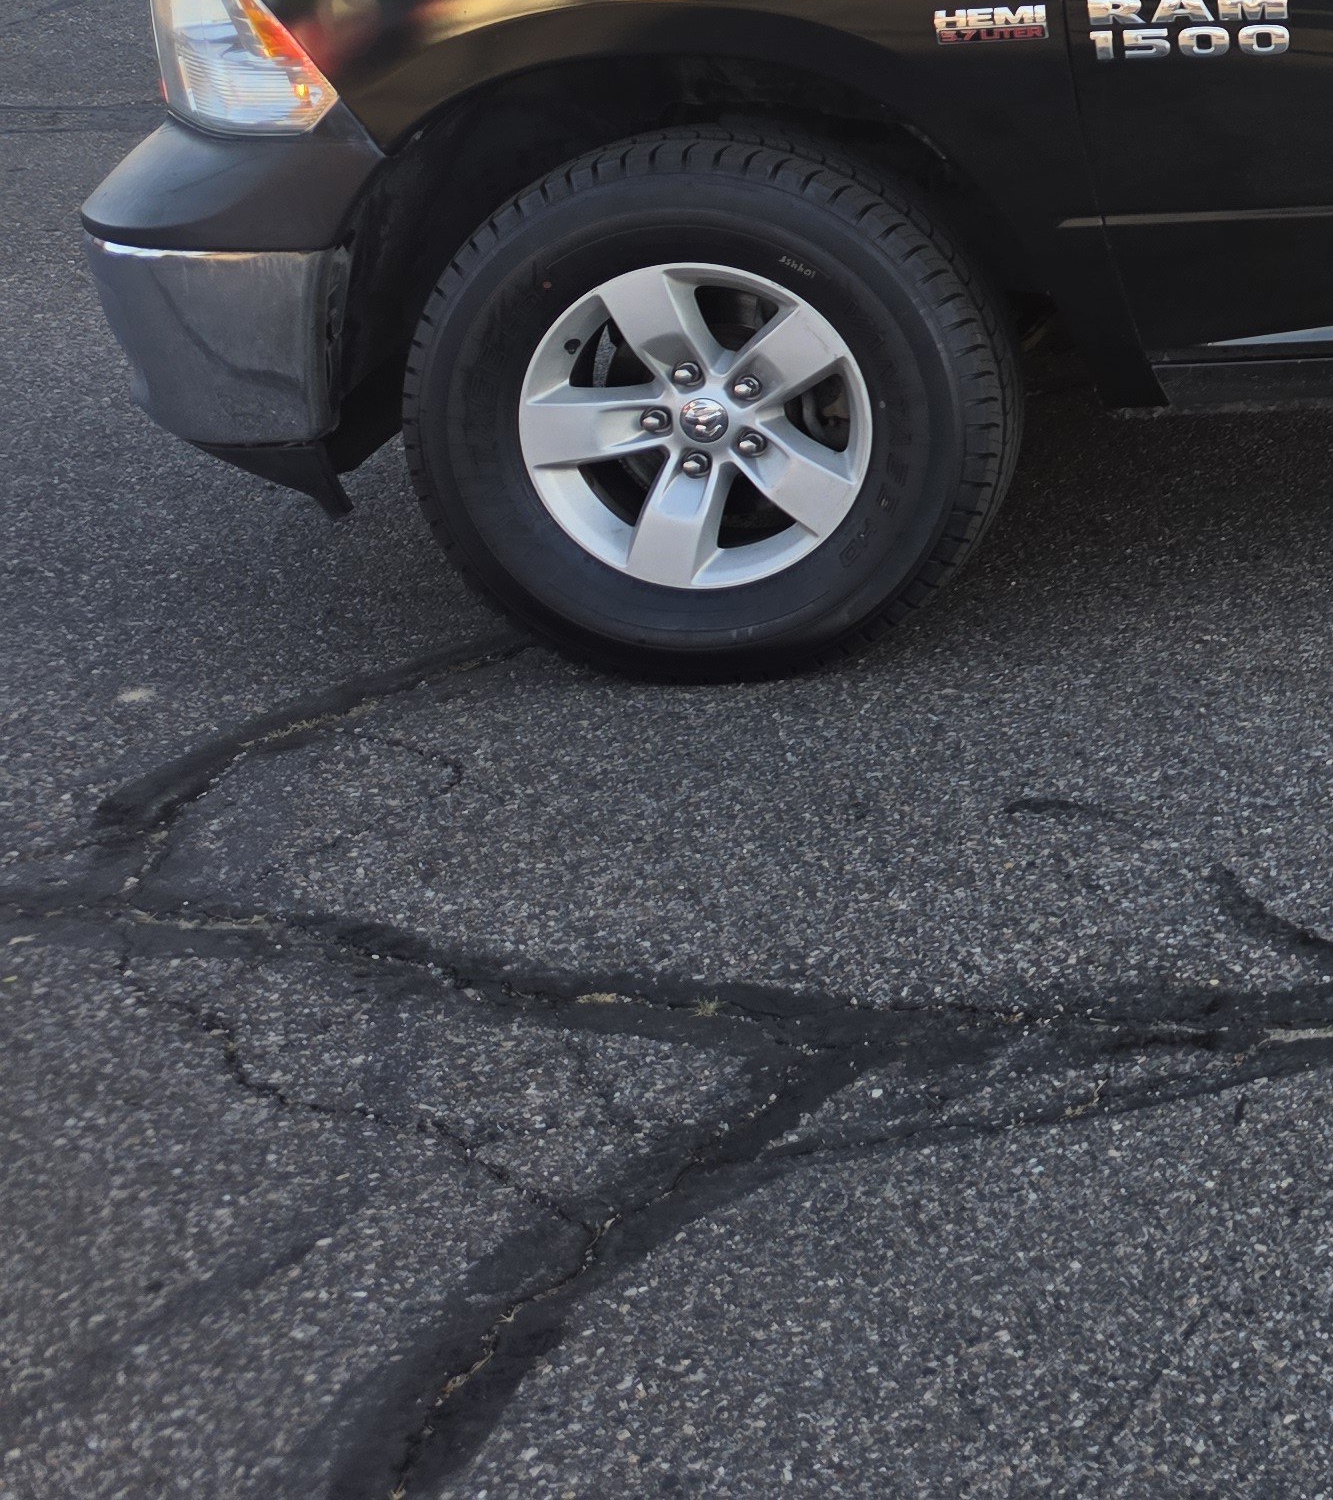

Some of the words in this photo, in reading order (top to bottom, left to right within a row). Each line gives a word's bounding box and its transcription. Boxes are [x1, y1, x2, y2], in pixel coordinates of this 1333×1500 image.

[934, 4, 1046, 29] HEMI
[981, 25, 1043, 40] LITER
[1089, 24, 1290, 61] 1500
